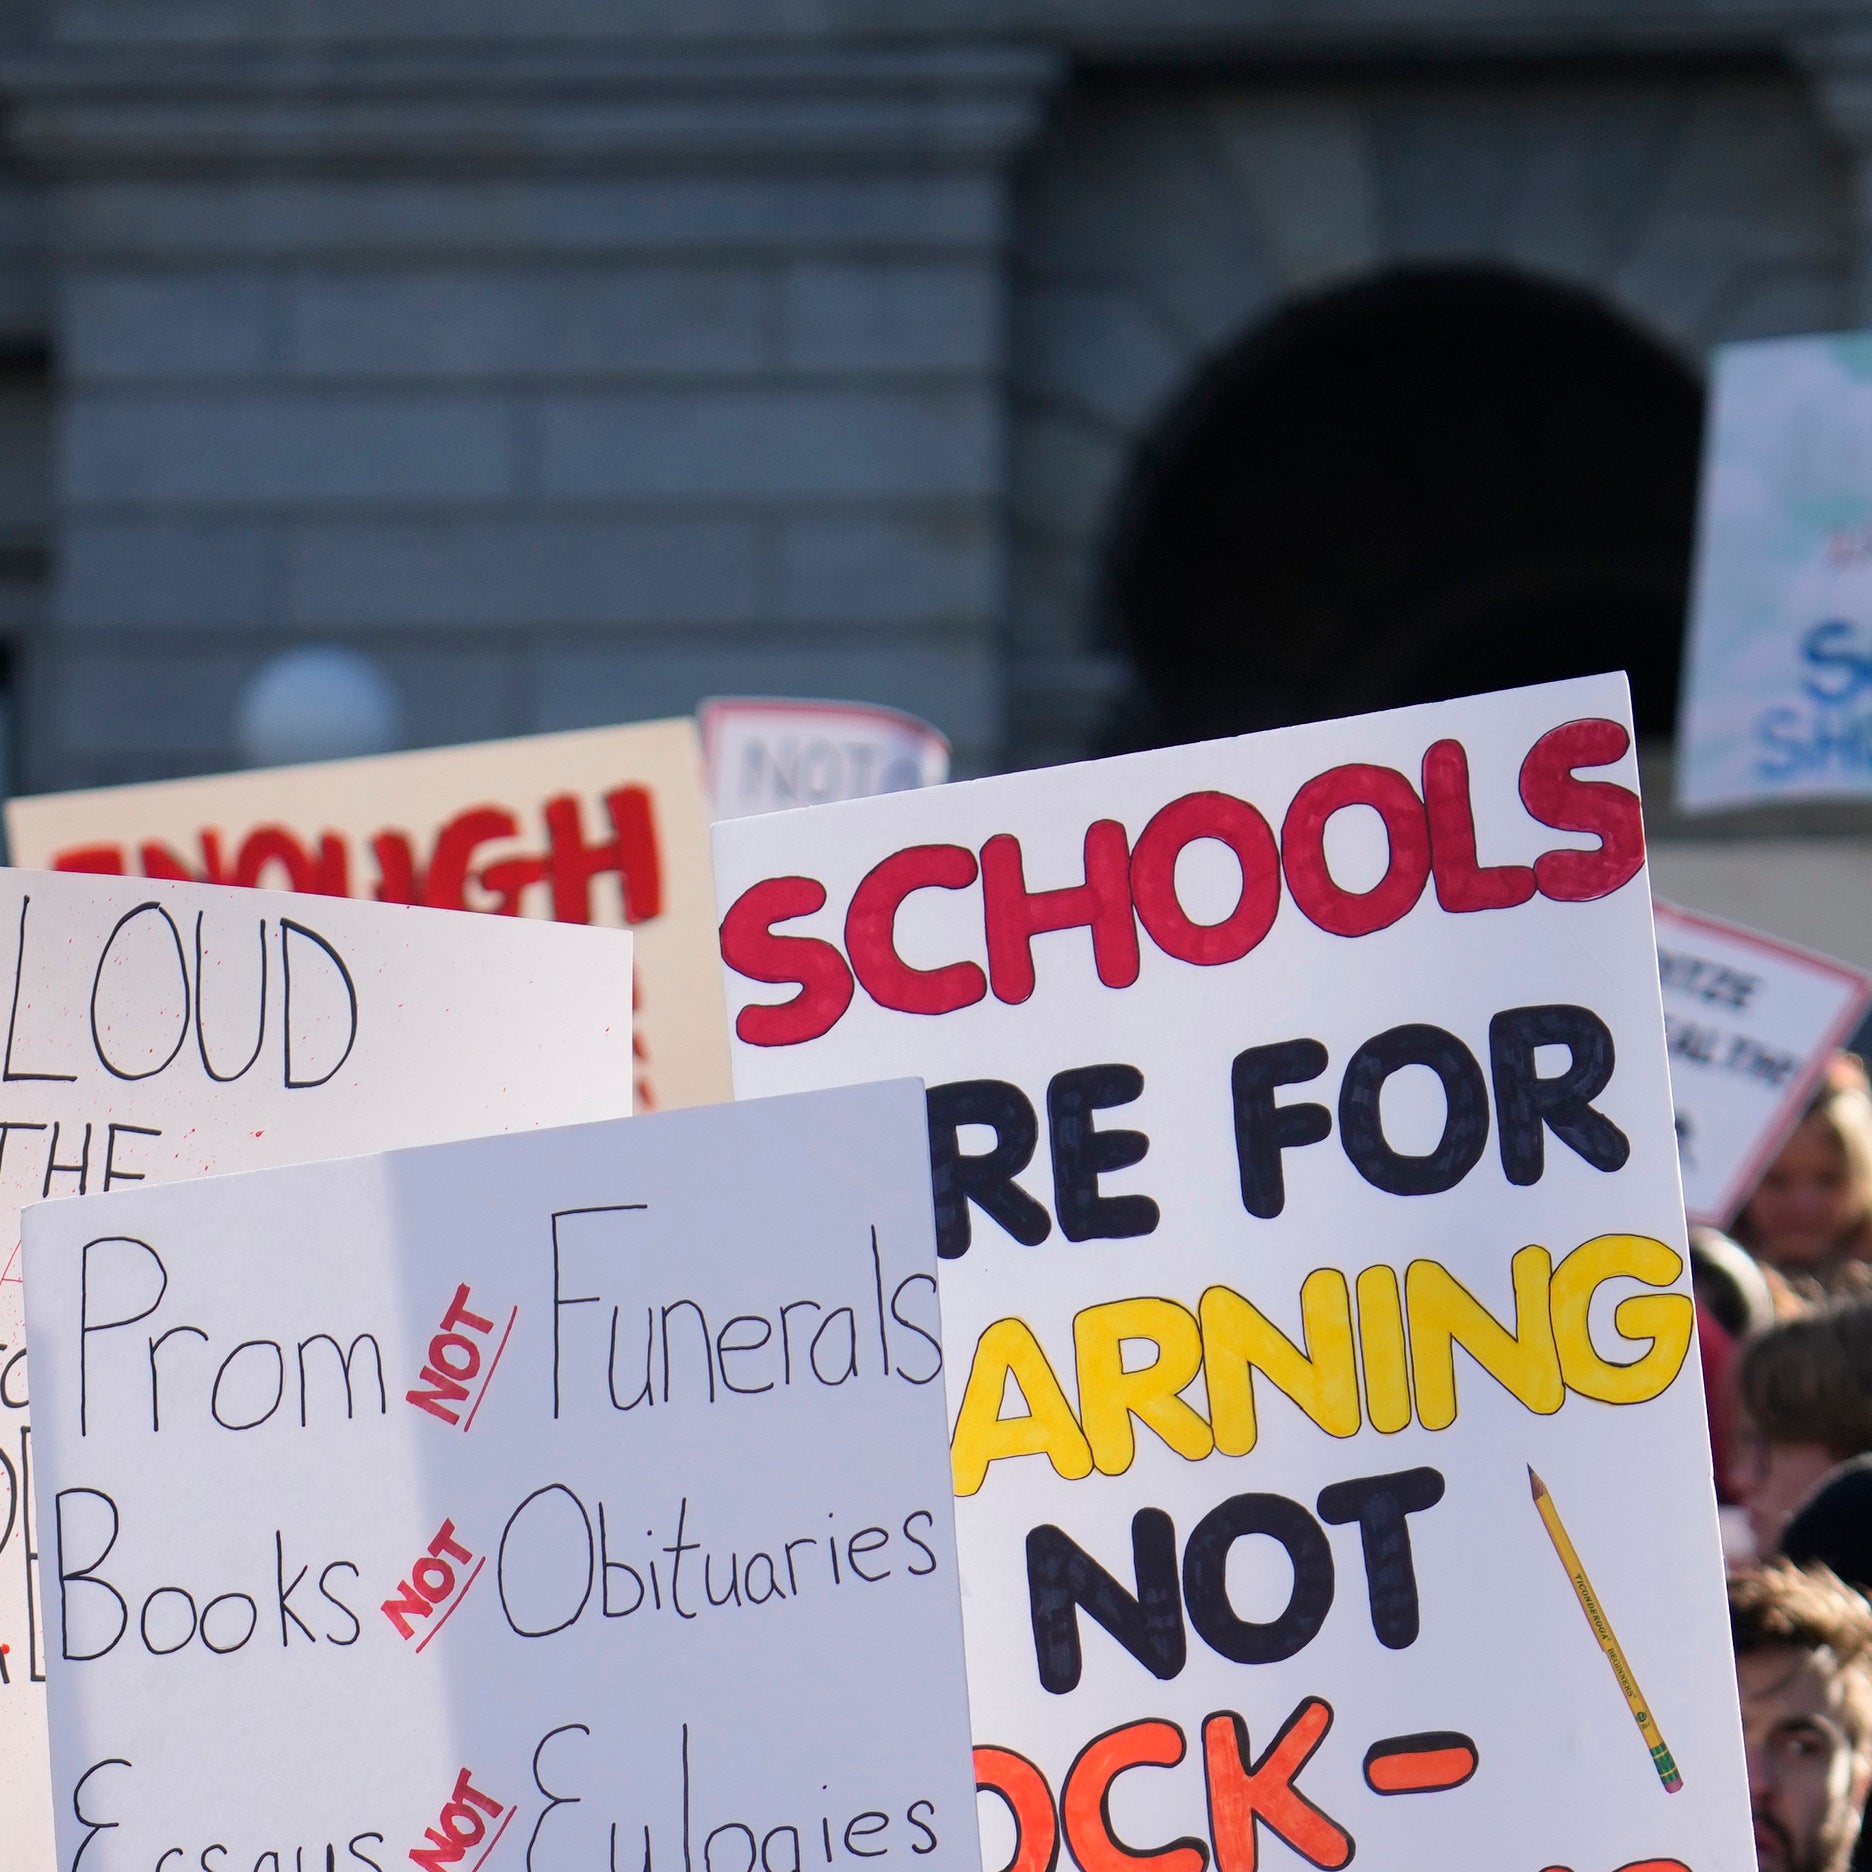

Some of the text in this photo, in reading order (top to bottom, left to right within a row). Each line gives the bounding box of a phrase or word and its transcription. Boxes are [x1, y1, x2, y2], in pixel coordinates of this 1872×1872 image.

[0, 895, 359, 1090] LOUD
[719, 716, 1646, 1047] SCHOOLS
[926, 1003, 1631, 1260] RE FOR
[78, 1202, 945, 1437] Prom NOT Funerals
[950, 1232, 1695, 1497] ARNING
[54, 1481, 939, 1662] Books NOT Obituaries
[1025, 1465, 1445, 1694] NOT
